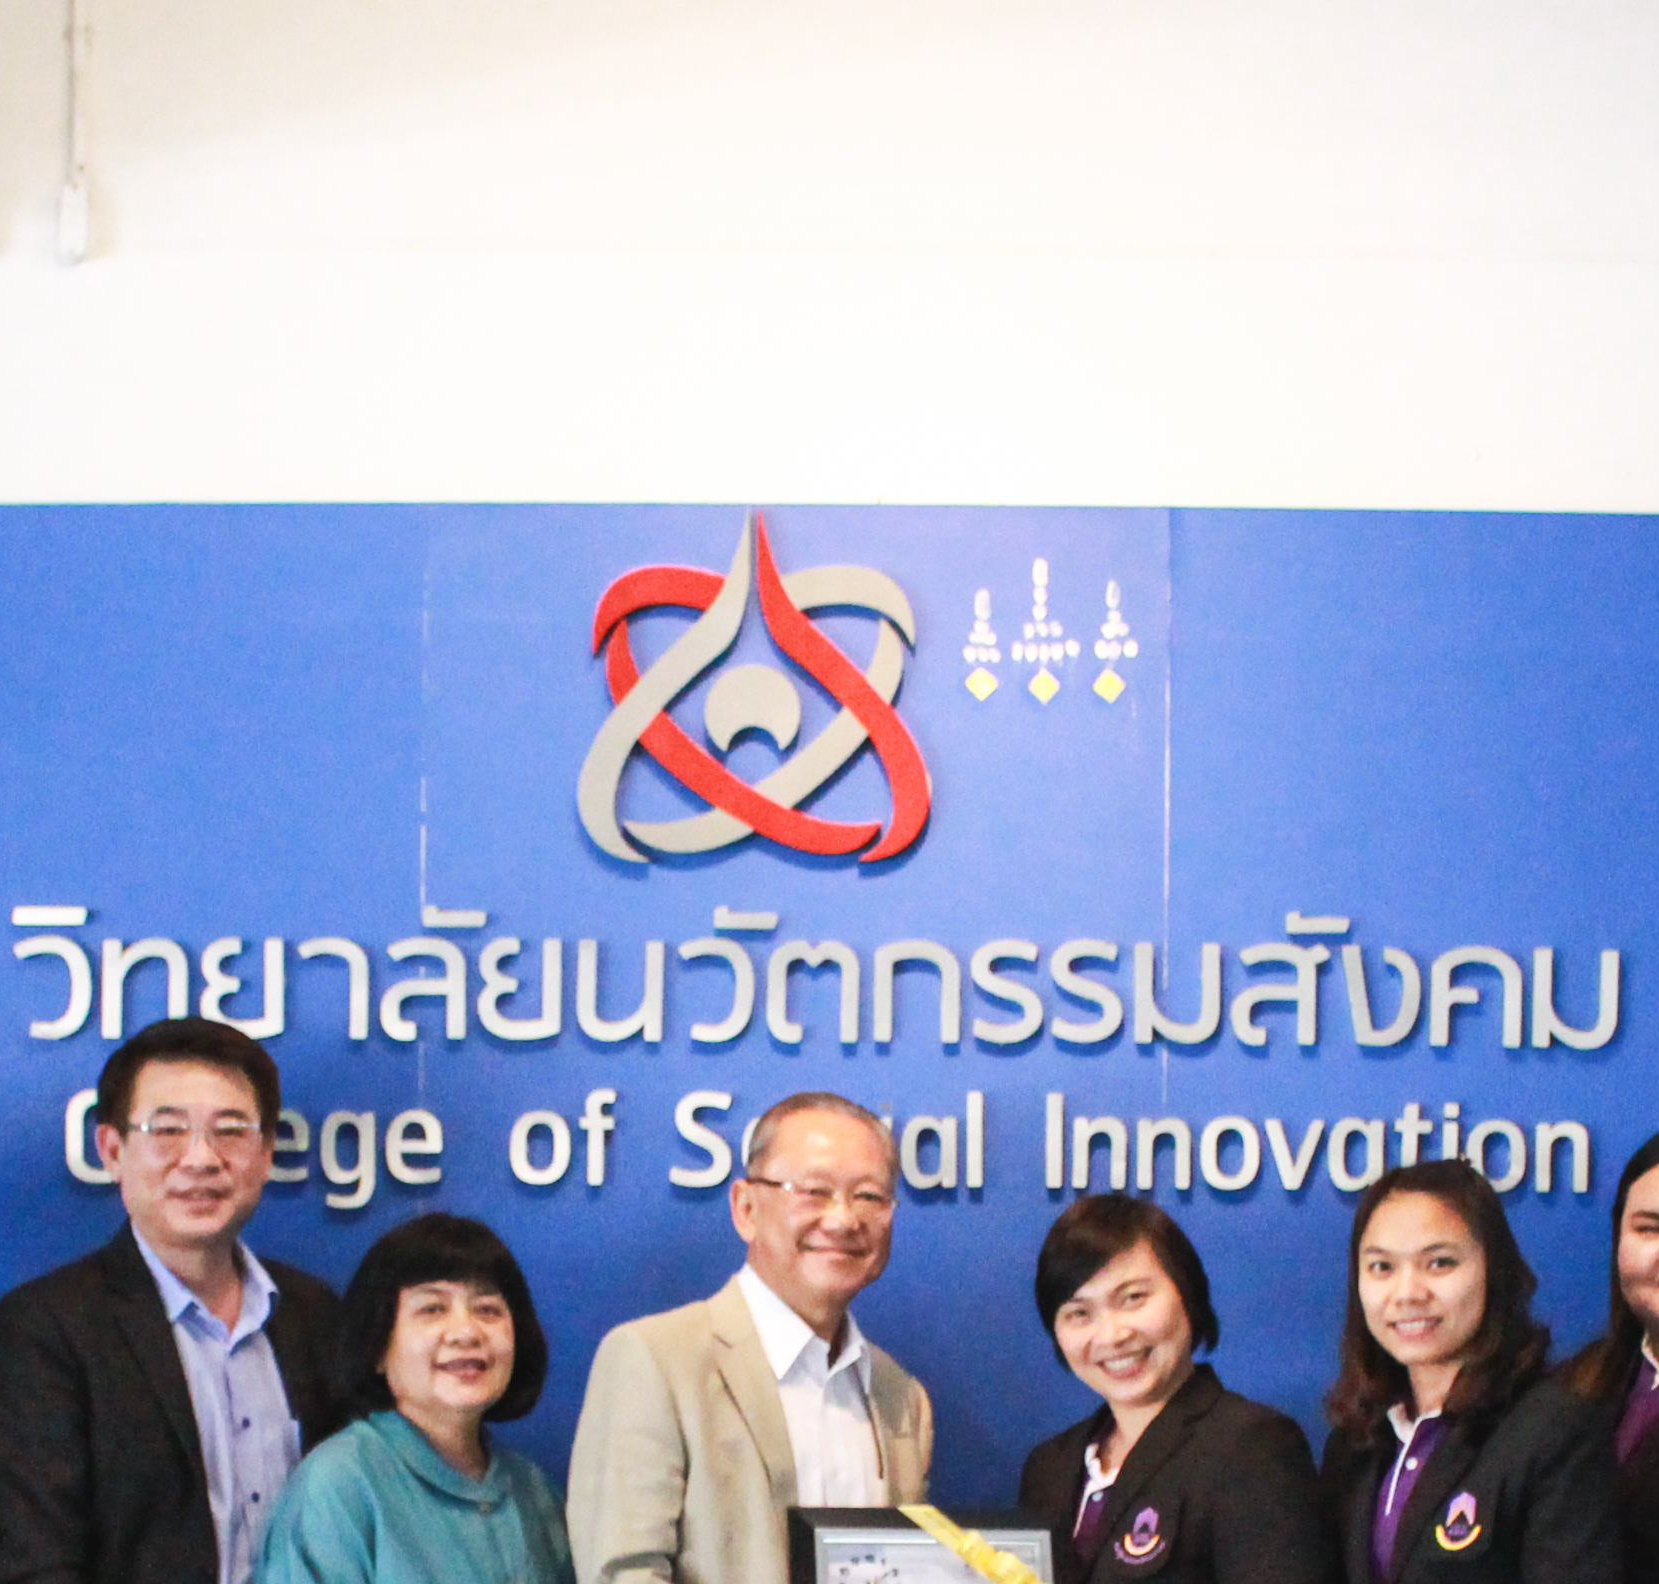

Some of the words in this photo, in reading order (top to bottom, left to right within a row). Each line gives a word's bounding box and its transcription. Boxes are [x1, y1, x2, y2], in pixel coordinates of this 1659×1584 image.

[10, 902, 1622, 1051] วิทยาลัยนวัตกรรมสังคม
[509, 1087, 618, 1188] of
[1045, 1092, 1591, 1194] Innovation
